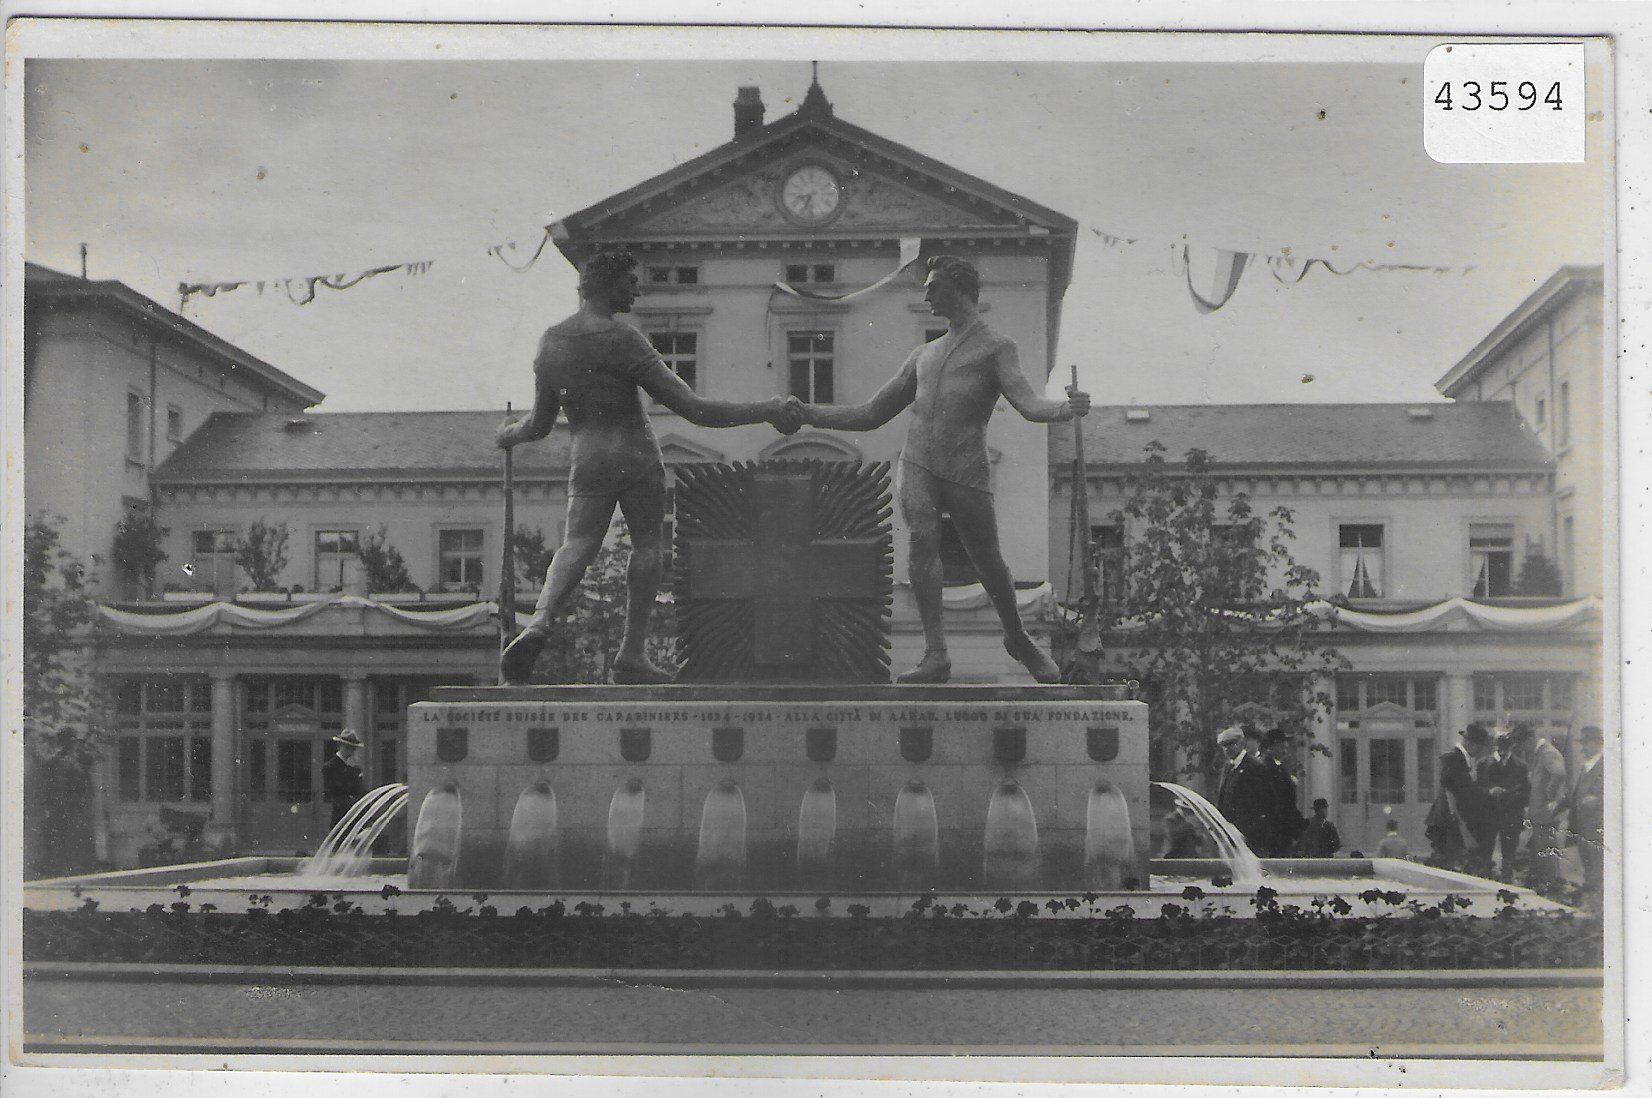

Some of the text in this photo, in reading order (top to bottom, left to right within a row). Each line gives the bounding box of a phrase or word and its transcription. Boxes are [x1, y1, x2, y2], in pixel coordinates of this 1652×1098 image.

[1434, 81, 1563, 111] 43594
[424, 712, 440, 721] LA
[506, 712, 555, 721] SUISSE
[563, 712, 588, 721] DES
[785, 712, 820, 721] ALLA
